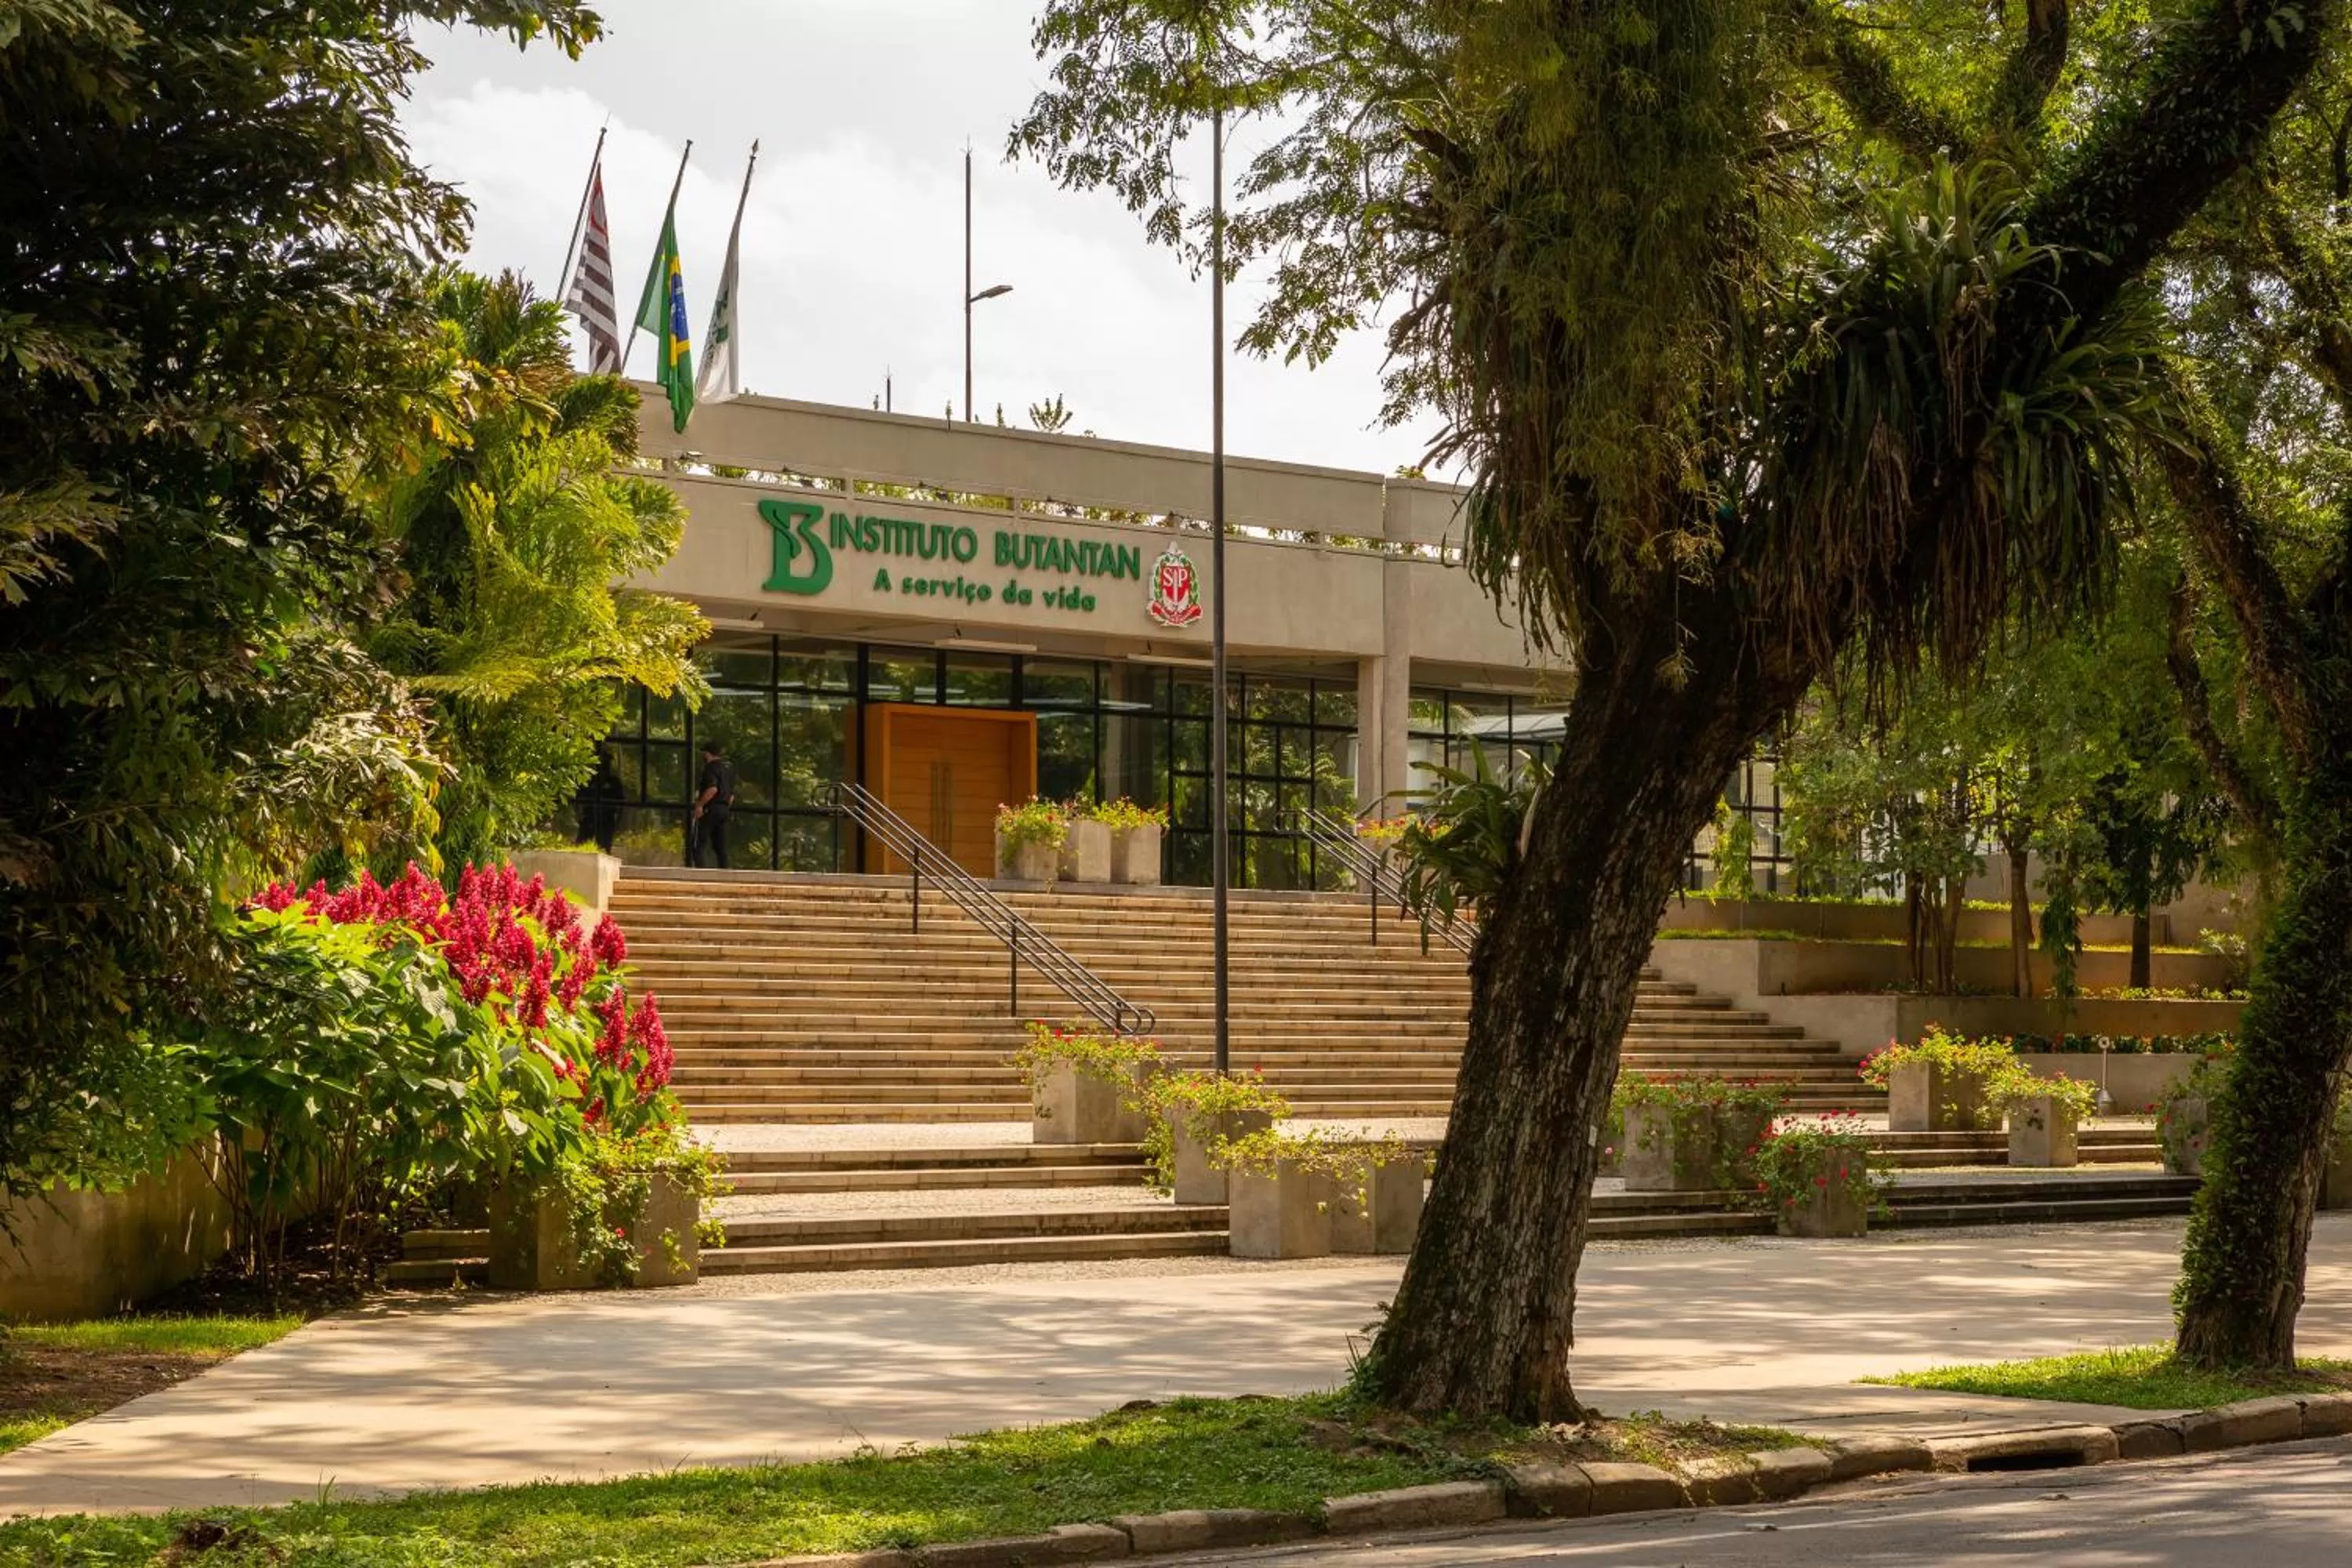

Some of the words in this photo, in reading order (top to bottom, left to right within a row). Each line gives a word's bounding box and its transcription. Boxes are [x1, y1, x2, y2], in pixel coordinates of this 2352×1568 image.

[829, 512, 979, 561] INSTITUTO
[993, 530, 1141, 580] BUTANTAN
[873, 567, 892, 592] A
[901, 575, 993, 602] serviço
[1001, 579, 1033, 604] da
[1041, 586, 1096, 612] vida
[1163, 567, 1188, 588] SP
